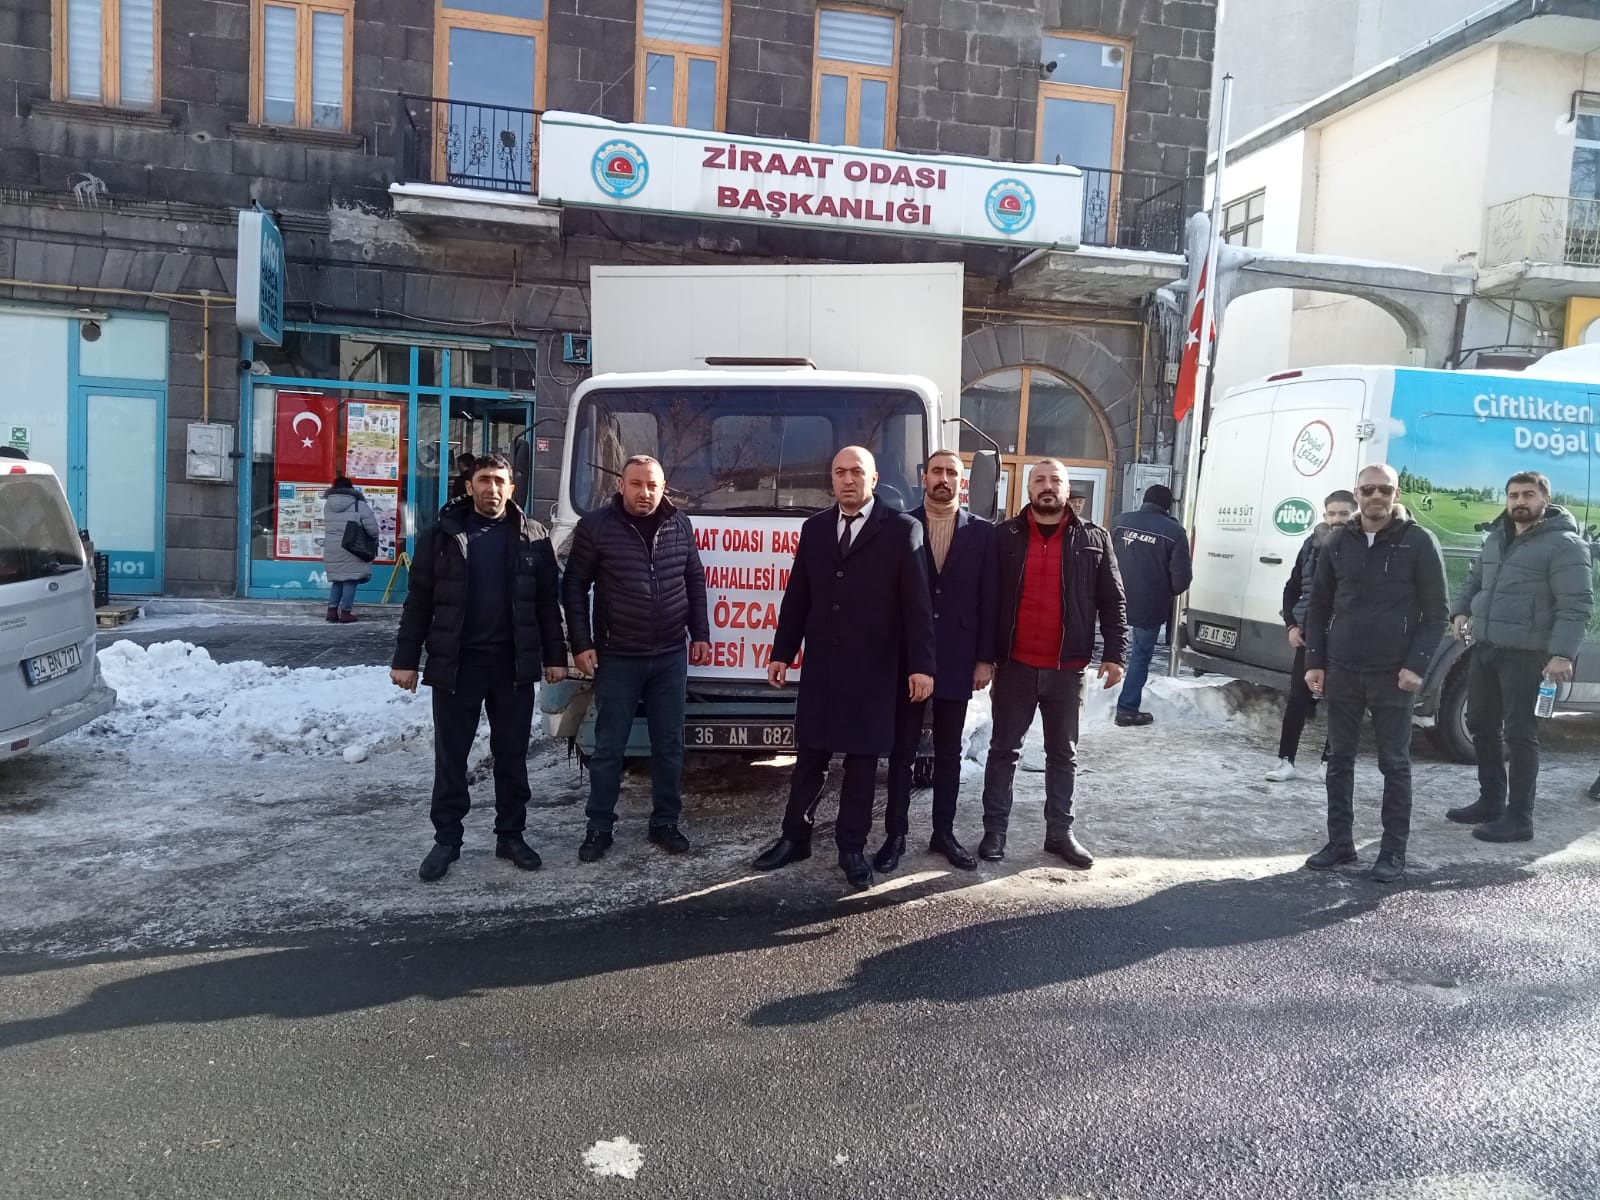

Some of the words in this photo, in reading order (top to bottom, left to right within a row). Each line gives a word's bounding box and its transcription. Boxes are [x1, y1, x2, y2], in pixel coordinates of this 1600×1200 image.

[702, 144, 833, 179] ZİRAAT
[843, 161, 947, 190] ODASI
[717, 186, 931, 225] BAŞKANLIĞI
[1473, 394, 1594, 423] Çiftlikten
[1300, 430, 1325, 452] Doğal
[1514, 426, 1589, 456] Doğal
[1297, 444, 1324, 468] Lezzet
[1239, 504, 1254, 516] SÜT
[722, 529, 764, 553] ODASI
[32, 660, 46, 677] 54
[47, 653, 62, 672] BN
[62, 647, 75, 667] 717
[695, 727, 714, 744] 36
[729, 727, 748, 745] AN
[762, 727, 792, 745] 082
